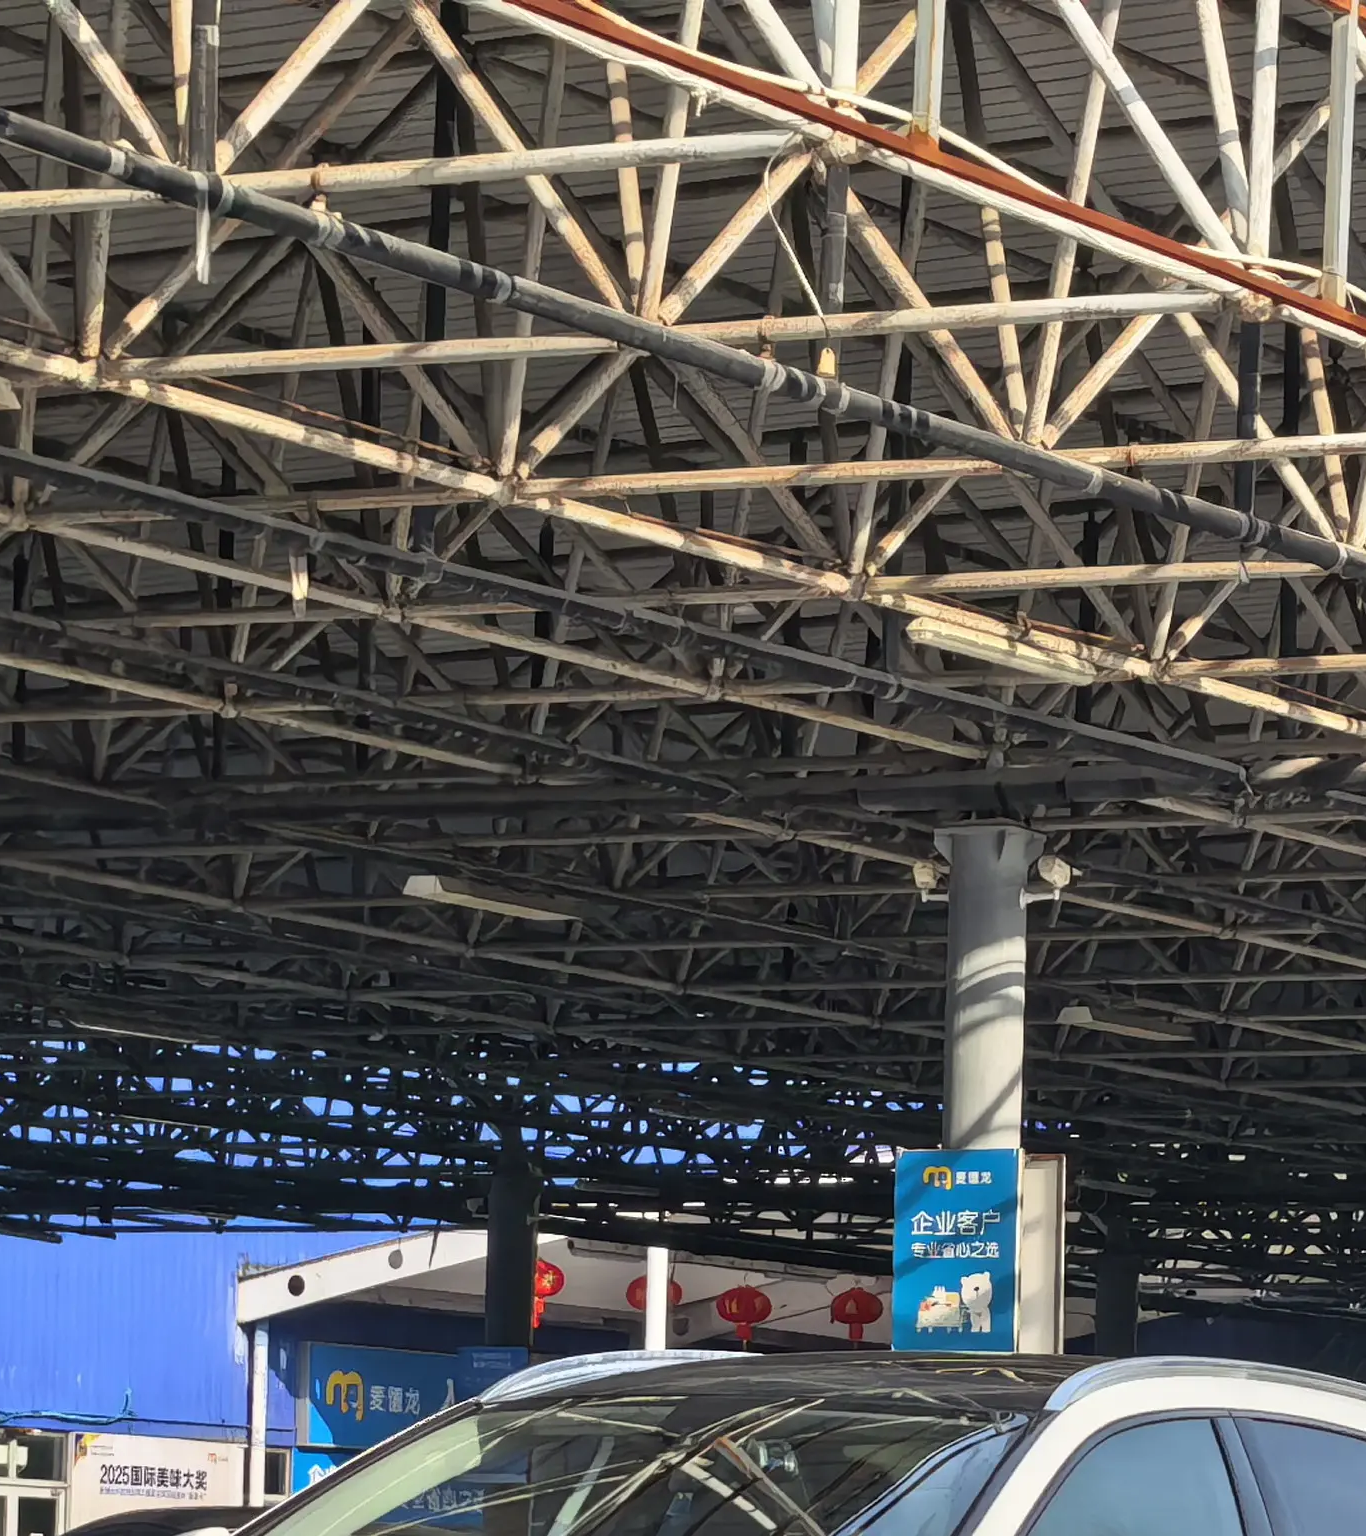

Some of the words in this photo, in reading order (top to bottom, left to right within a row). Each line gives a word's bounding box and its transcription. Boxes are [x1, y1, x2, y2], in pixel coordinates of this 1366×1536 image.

[910, 1208, 1001, 1236] 企业客户
[910, 1240, 1000, 1258] 专业省心之选
[99, 1464, 208, 1491] 2025国际美味大奖
